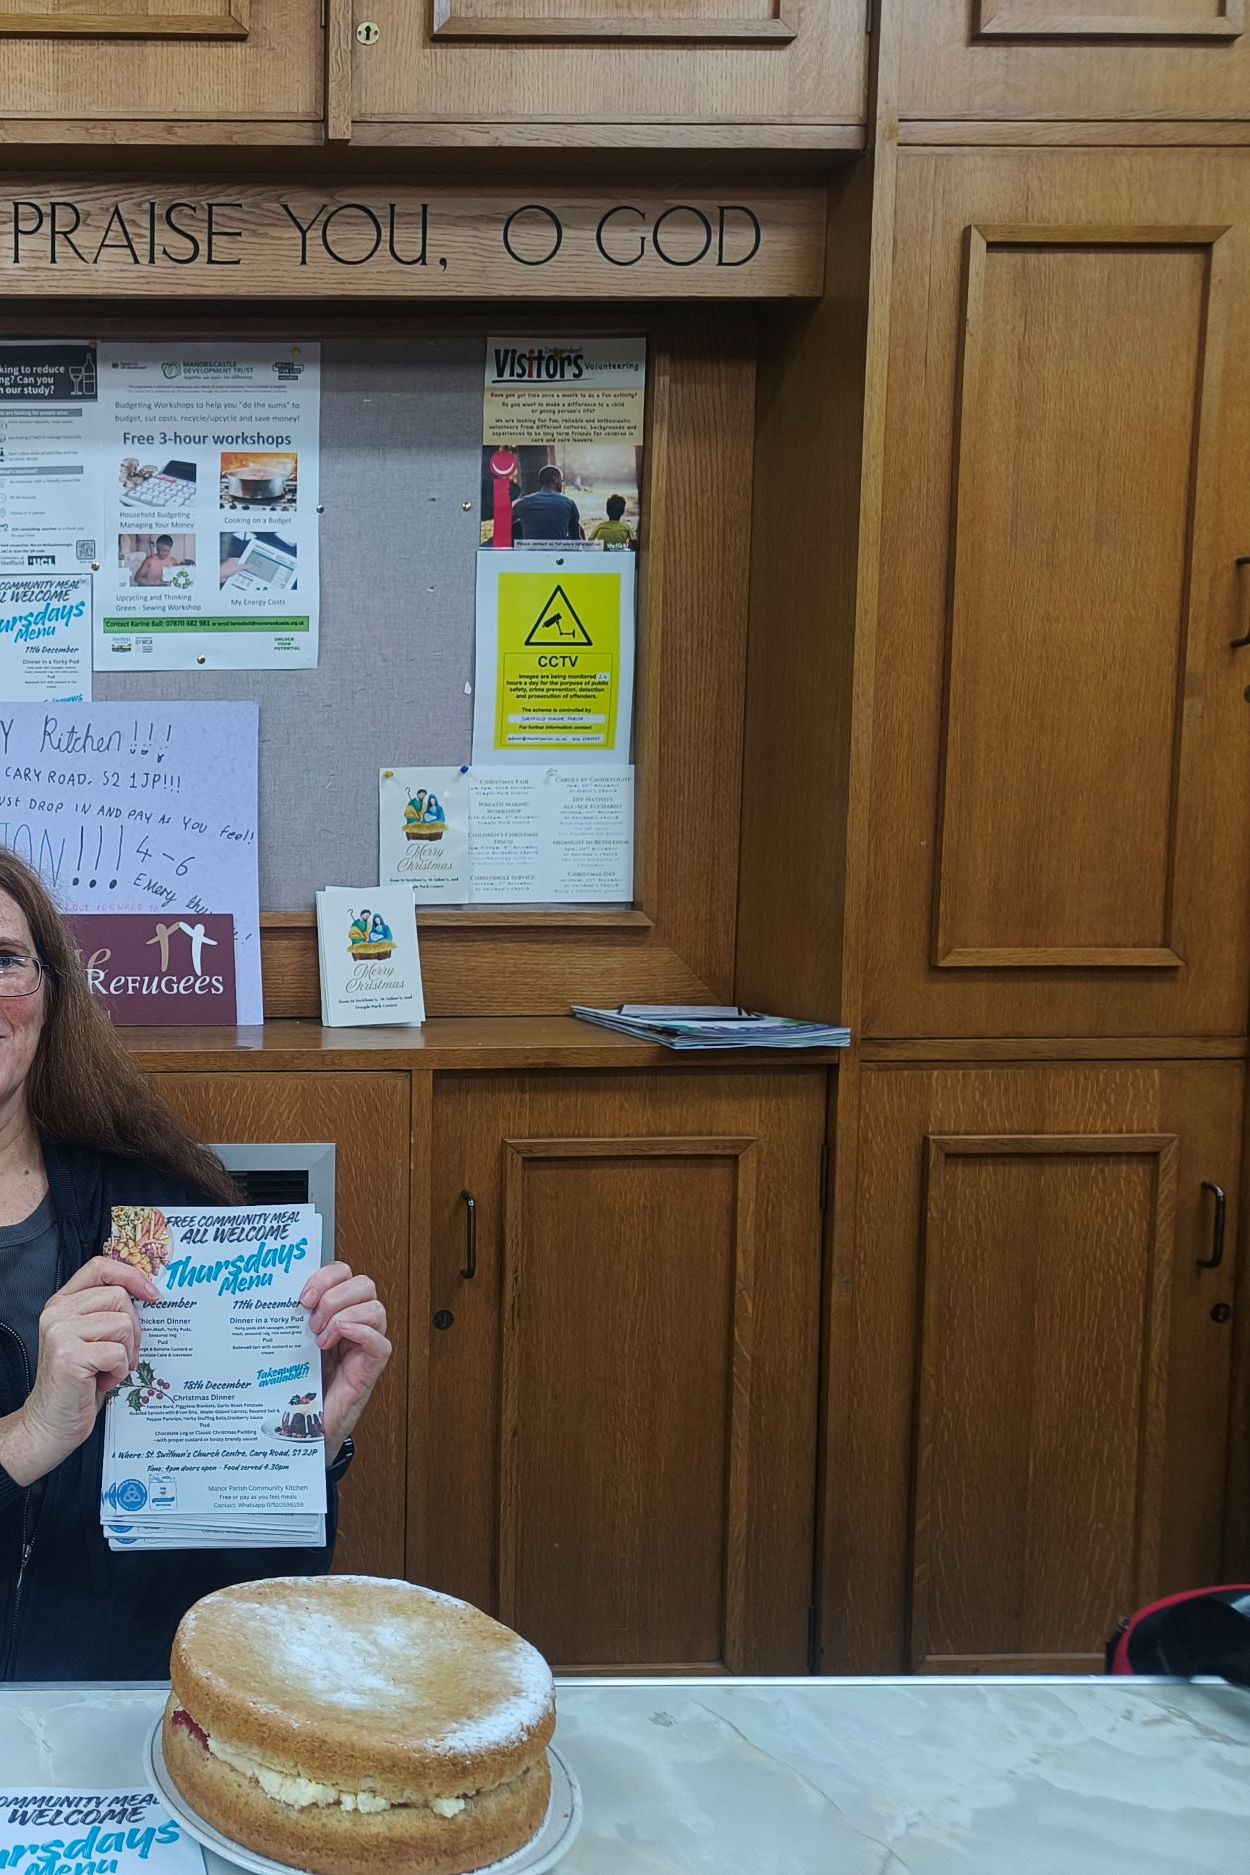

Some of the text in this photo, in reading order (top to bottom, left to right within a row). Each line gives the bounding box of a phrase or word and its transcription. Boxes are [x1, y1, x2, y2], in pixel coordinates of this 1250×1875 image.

[11, 201, 242, 266] PRAISE
[281, 203, 449, 272] YOU,
[503, 204, 563, 266] O
[596, 205, 761, 267] GOD
[33, 365, 65, 373] reduce
[584, 362, 639, 371] Volunteering
[17, 376, 34, 384] Can
[37, 376, 53, 385] you
[24, 385, 54, 396] study?
[123, 432, 291, 447] Free 3-hour workshops
[224, 517, 251, 525] Cooking
[269, 517, 291, 525] Budget
[0, 581, 56, 591] COMMUNITY
[57, 580, 79, 589] MEAL
[10, 590, 70, 603] WELCOME
[231, 598, 286, 607] My Energy Costs
[14, 627, 55, 643] Menu
[538, 656, 578, 667] CCTV
[5, 765, 42, 782] CARY
[48, 771, 92, 785] ROAD.
[103, 771, 119, 787] S2
[130, 773, 180, 793] 1JP!!!
[29, 799, 63, 813] DROP
[75, 804, 91, 814] IN
[97, 805, 121, 818] AND
[127, 810, 153, 824] PAY
[183, 816, 207, 833] YOU
[405, 843, 445, 858] Merry
[397, 858, 453, 872] Christmas
[354, 963, 394, 980] Merry
[346, 979, 405, 993] Christmas
[167, 1211, 299, 1228] FREE COMMUNITY MEAL
[180, 1224, 291, 1244] ALL WELCOME
[166, 1237, 308, 1290] Thursdays
[218, 1272, 272, 1296] Menu
[233, 1300, 300, 1309] 11th December
[270, 1316, 289, 1324] Yorky
[256, 1362, 309, 1379] Takeaways
[183, 1380, 251, 1390] 18th December
[156, 1450, 191, 1458] Swithun's
[193, 1450, 219, 1458] Church
[221, 1450, 247, 1458] Centre,
[249, 1450, 267, 1458] Cary
[7, 1806, 145, 1826] WELCOME
